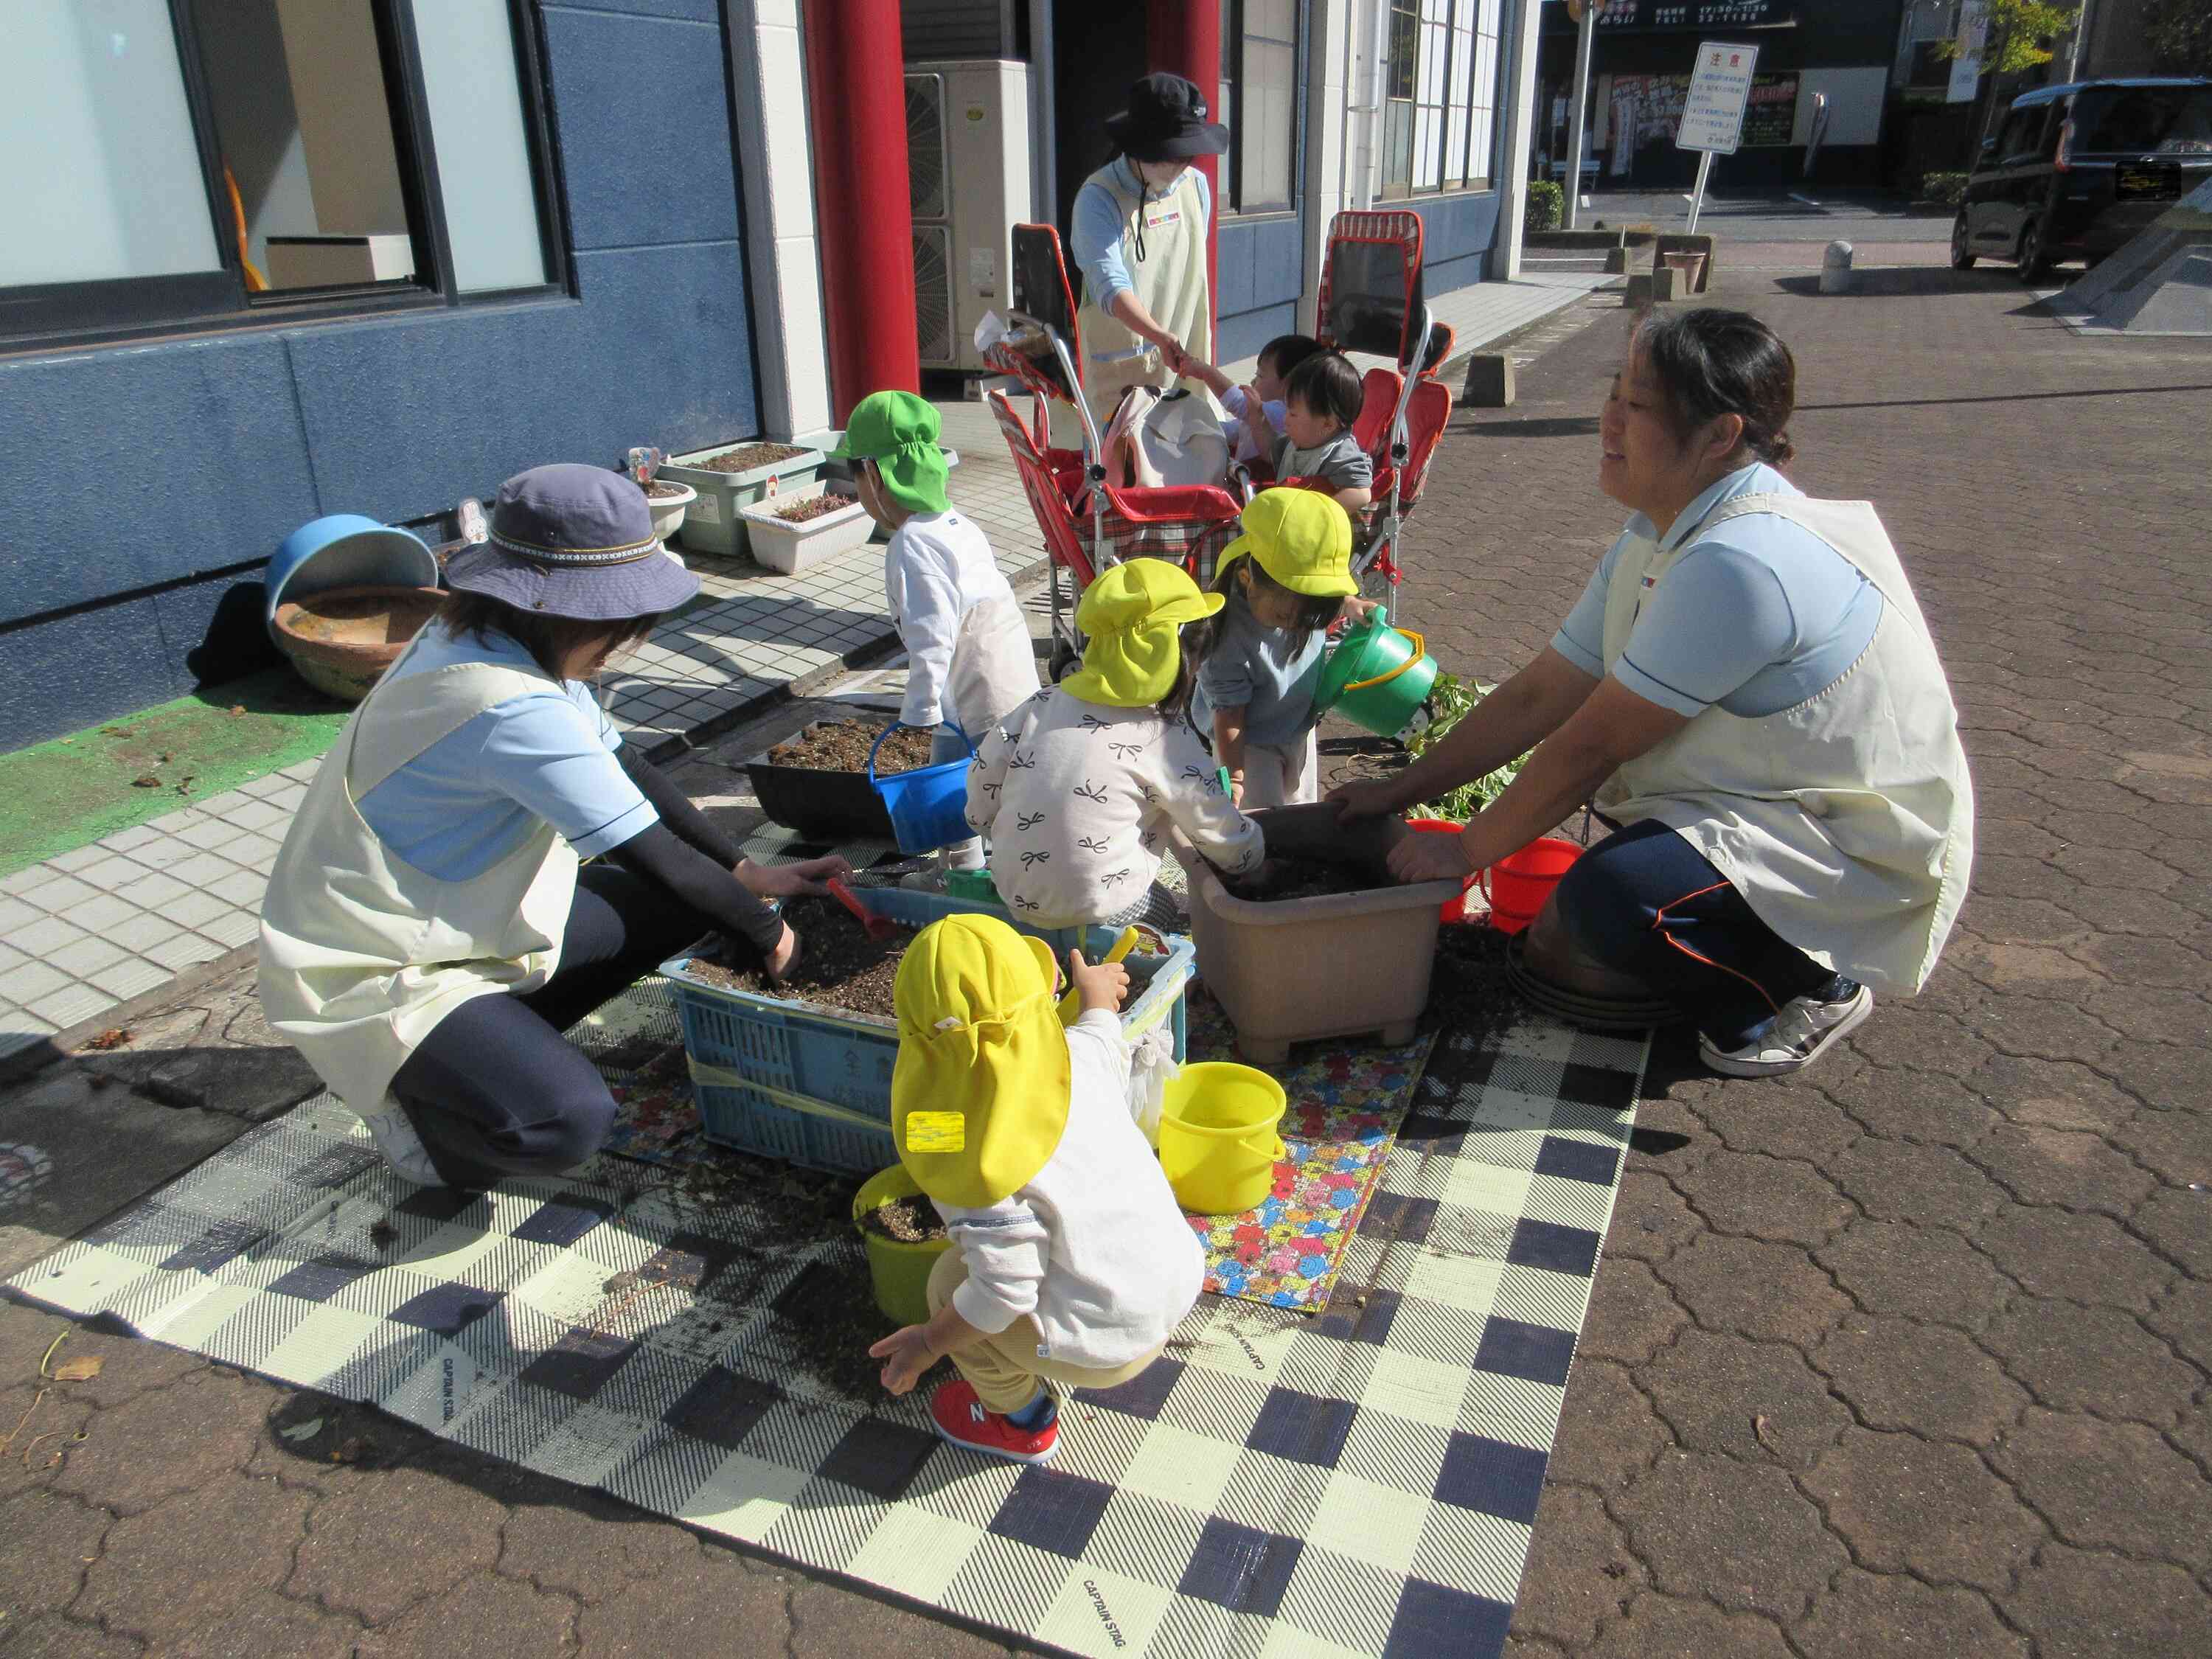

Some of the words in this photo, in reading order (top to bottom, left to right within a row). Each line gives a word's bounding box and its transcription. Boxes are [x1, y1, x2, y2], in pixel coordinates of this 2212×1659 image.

[443, 1358, 453, 1397] CAPTAIN
[970, 1402, 985, 1422] N
[1083, 1580, 1113, 1621] CAPTAIN
[1105, 1621, 1127, 1648] STAG
